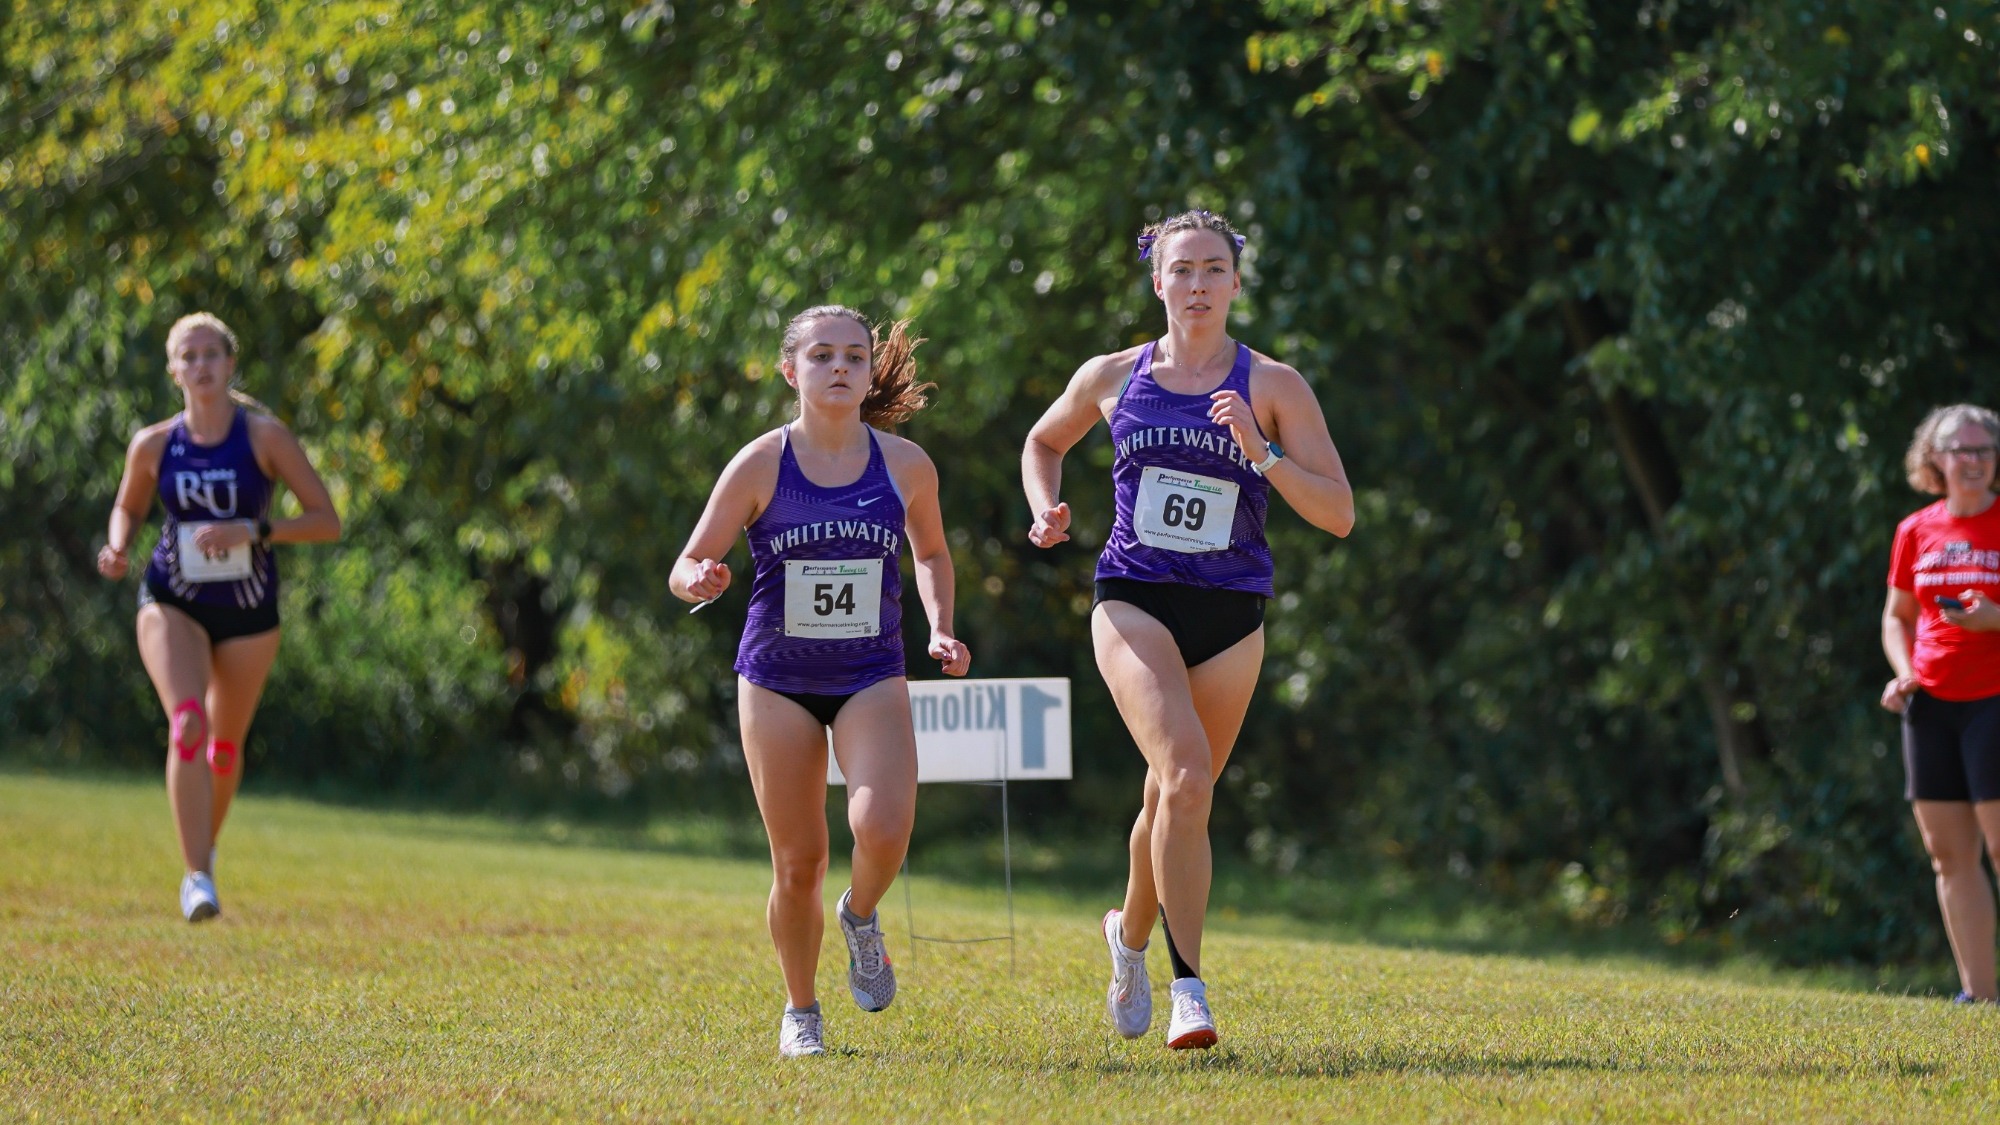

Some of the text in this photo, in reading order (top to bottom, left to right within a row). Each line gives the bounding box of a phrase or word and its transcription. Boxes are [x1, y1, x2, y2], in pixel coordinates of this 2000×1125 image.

[1163, 494, 1206, 531] 69
[770, 521, 898, 555] WHITEWATER
[814, 583, 855, 616] 54
